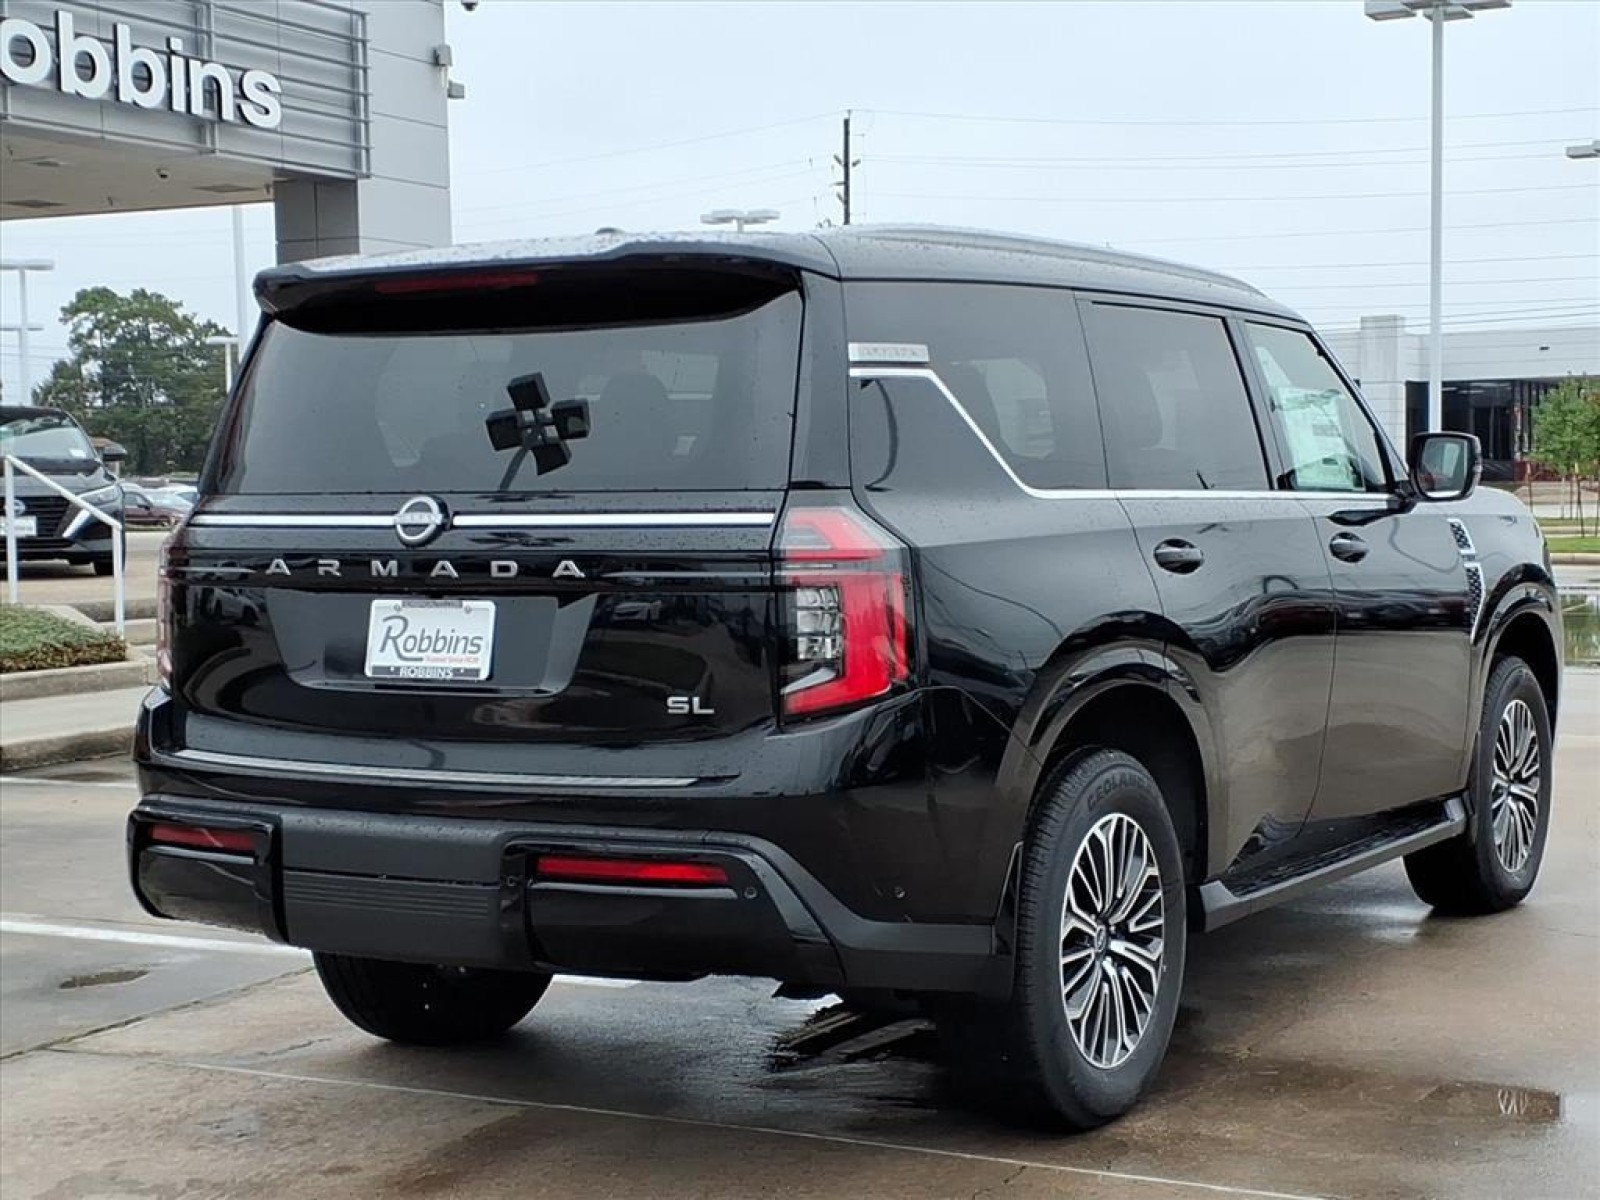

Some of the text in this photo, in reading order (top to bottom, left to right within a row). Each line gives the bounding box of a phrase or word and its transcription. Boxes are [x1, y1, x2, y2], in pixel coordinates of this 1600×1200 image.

[0, 10, 283, 129] obbins
[265, 558, 585, 579] ARMADA
[379, 615, 483, 661] Robbins
[667, 697, 714, 714] SL
